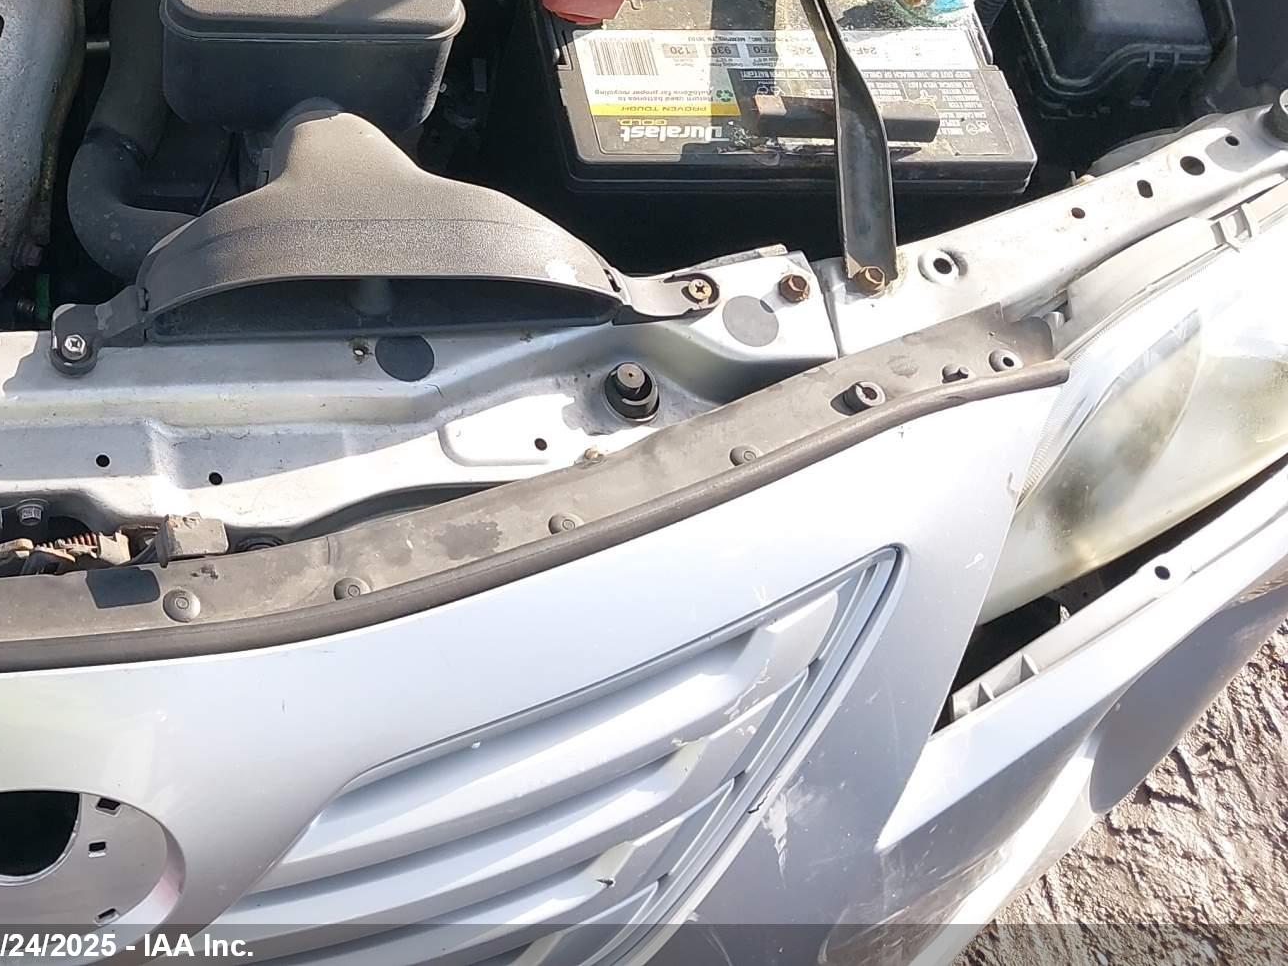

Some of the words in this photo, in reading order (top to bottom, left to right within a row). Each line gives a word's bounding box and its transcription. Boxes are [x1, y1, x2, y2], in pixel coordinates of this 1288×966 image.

[710, 46, 732, 55] 930
[893, 70, 915, 78] REACH
[915, 70, 929, 78] THE
[929, 70, 940, 78] OF
[940, 70, 954, 78] OUT
[954, 70, 972, 78] KEEP
[620, 125, 725, 143] Duralast
